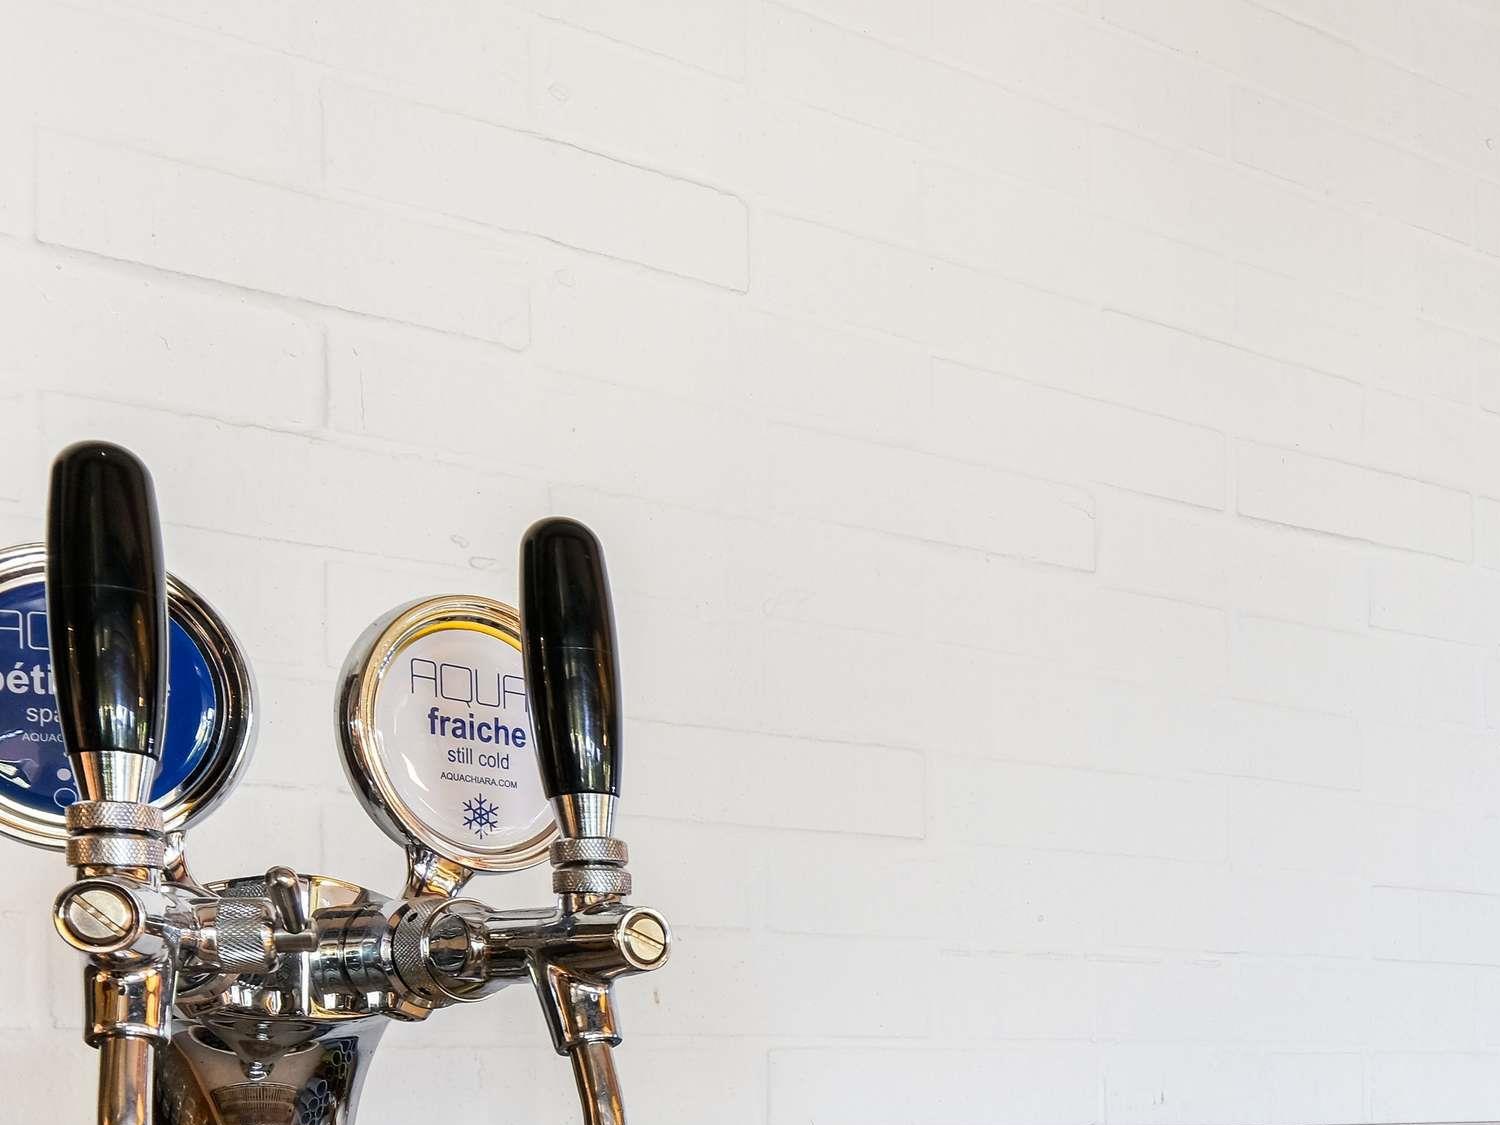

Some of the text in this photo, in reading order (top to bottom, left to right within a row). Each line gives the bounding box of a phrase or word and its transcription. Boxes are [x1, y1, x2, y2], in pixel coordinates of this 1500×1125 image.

[410, 657, 528, 712] AQUA
[427, 707, 527, 748] fraiche
[447, 747, 510, 770] still cold
[440, 771, 518, 789] AQUACHIARA.COM
